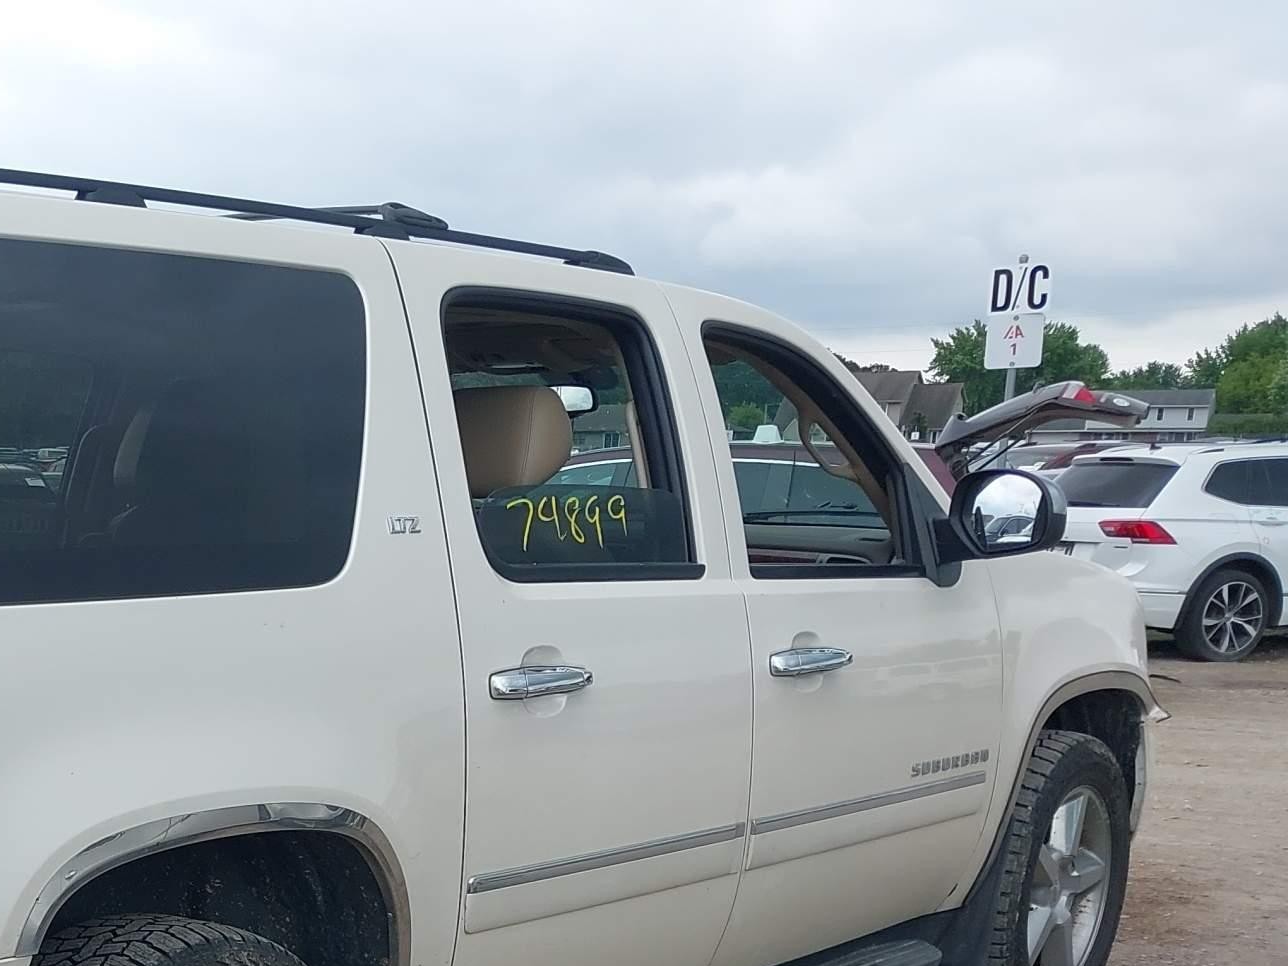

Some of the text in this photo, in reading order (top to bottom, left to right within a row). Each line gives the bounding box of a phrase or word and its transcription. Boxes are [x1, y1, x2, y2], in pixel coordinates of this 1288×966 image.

[991, 265, 1049, 312] D/C
[1010, 343, 1017, 356] 1
[387, 516, 422, 535] LTZ
[911, 749, 990, 778] SUBURBAN
